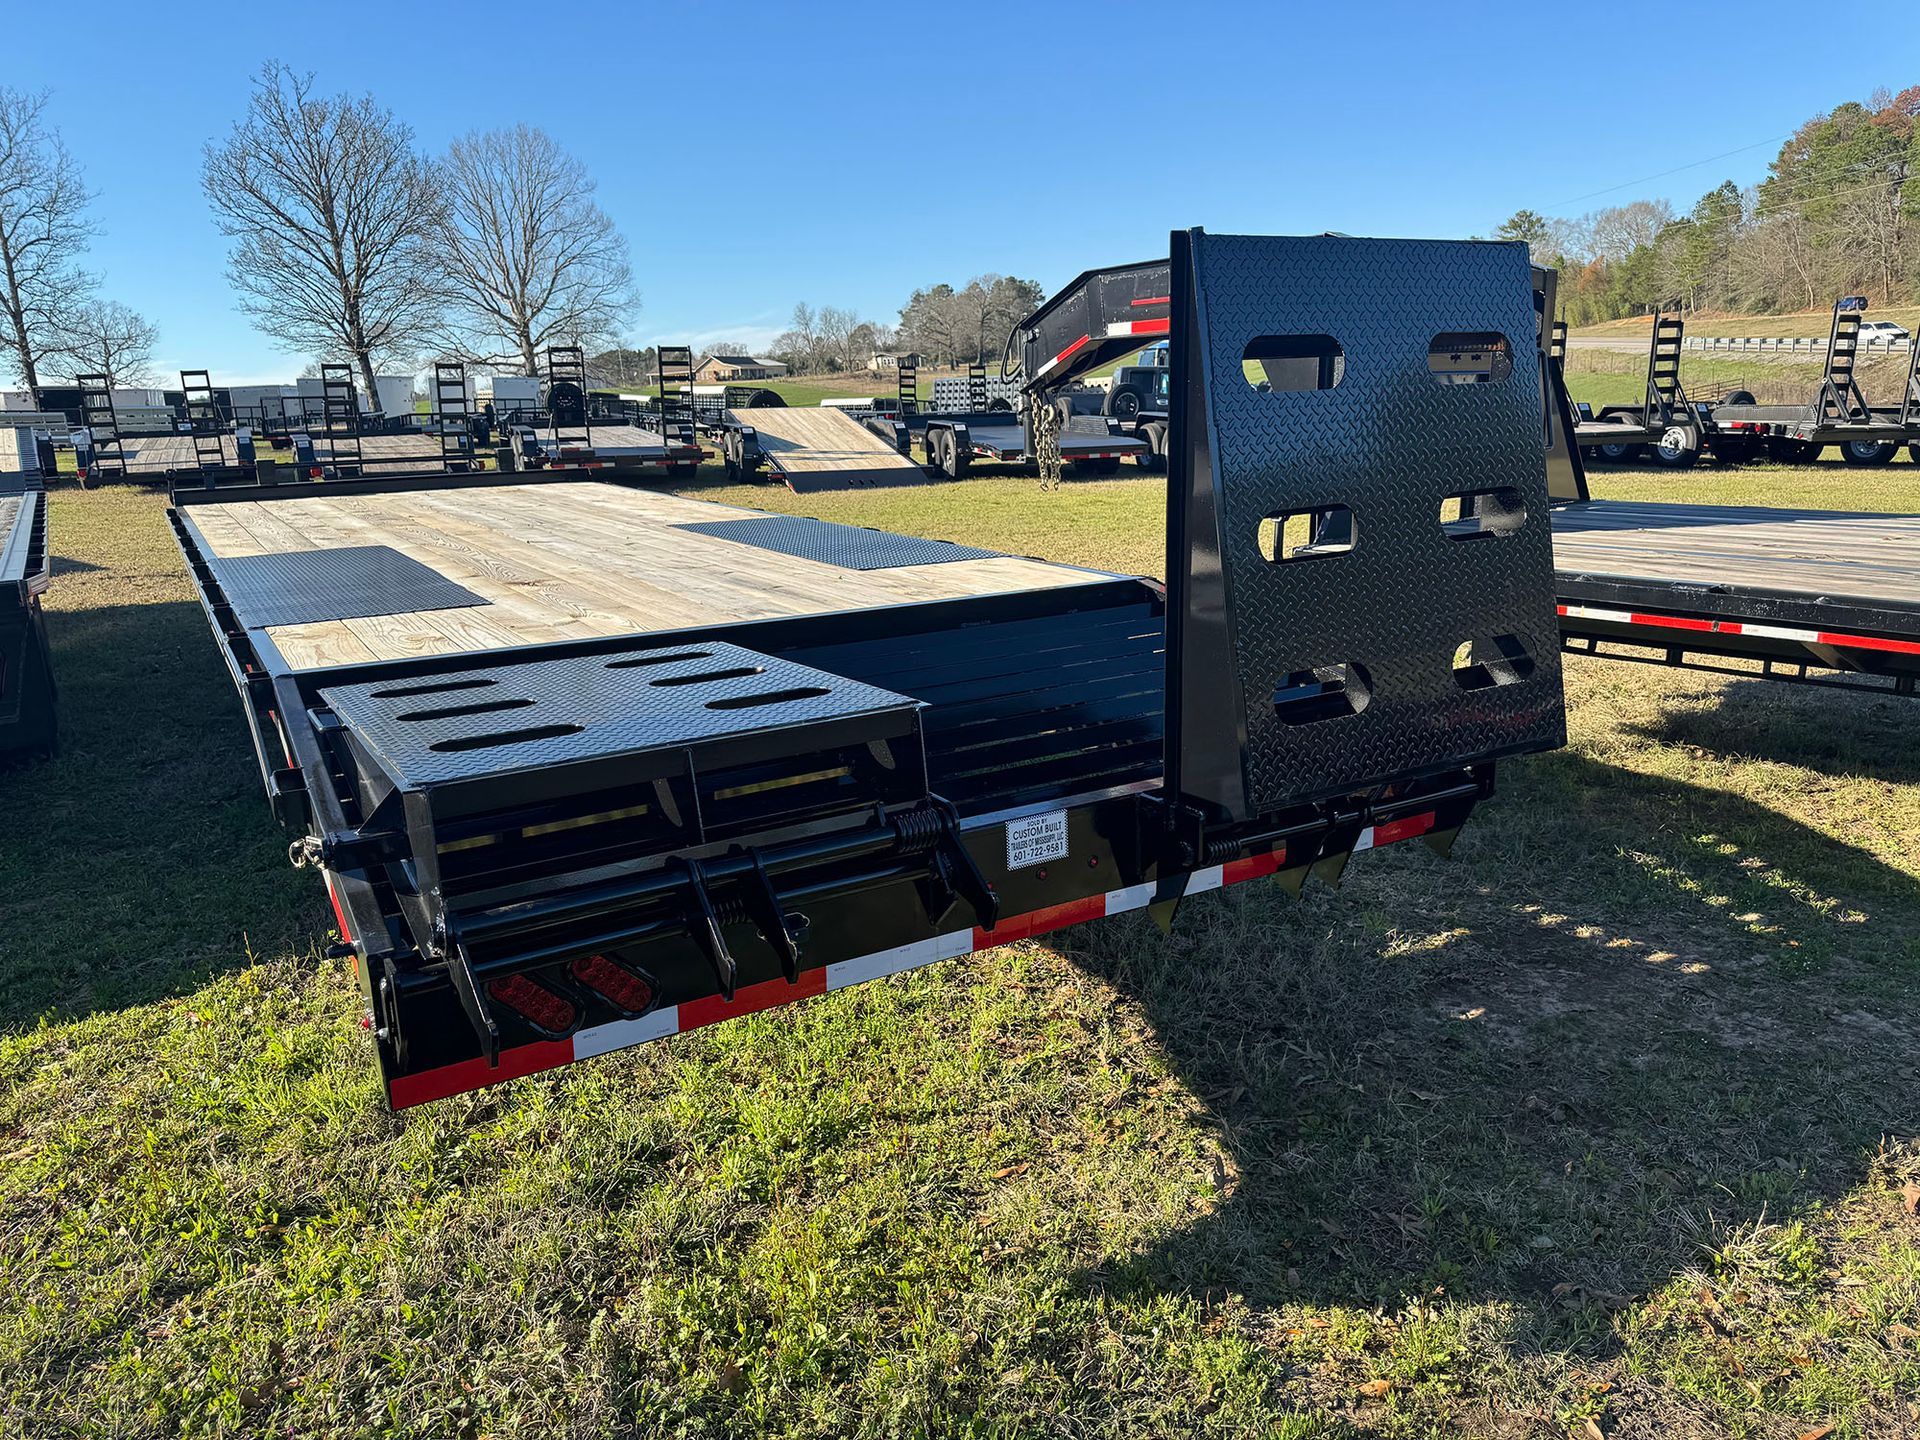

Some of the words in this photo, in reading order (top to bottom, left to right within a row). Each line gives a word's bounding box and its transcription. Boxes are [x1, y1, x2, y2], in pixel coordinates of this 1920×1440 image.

[1013, 825, 1043, 840] CUSTOM
[1045, 821, 1062, 833] BUILT
[1011, 839, 1028, 851] TRAILERS
[1028, 838, 1035, 847] OF
[1057, 831, 1065, 841] LLC
[1013, 841, 1063, 861] 601-722-9581
